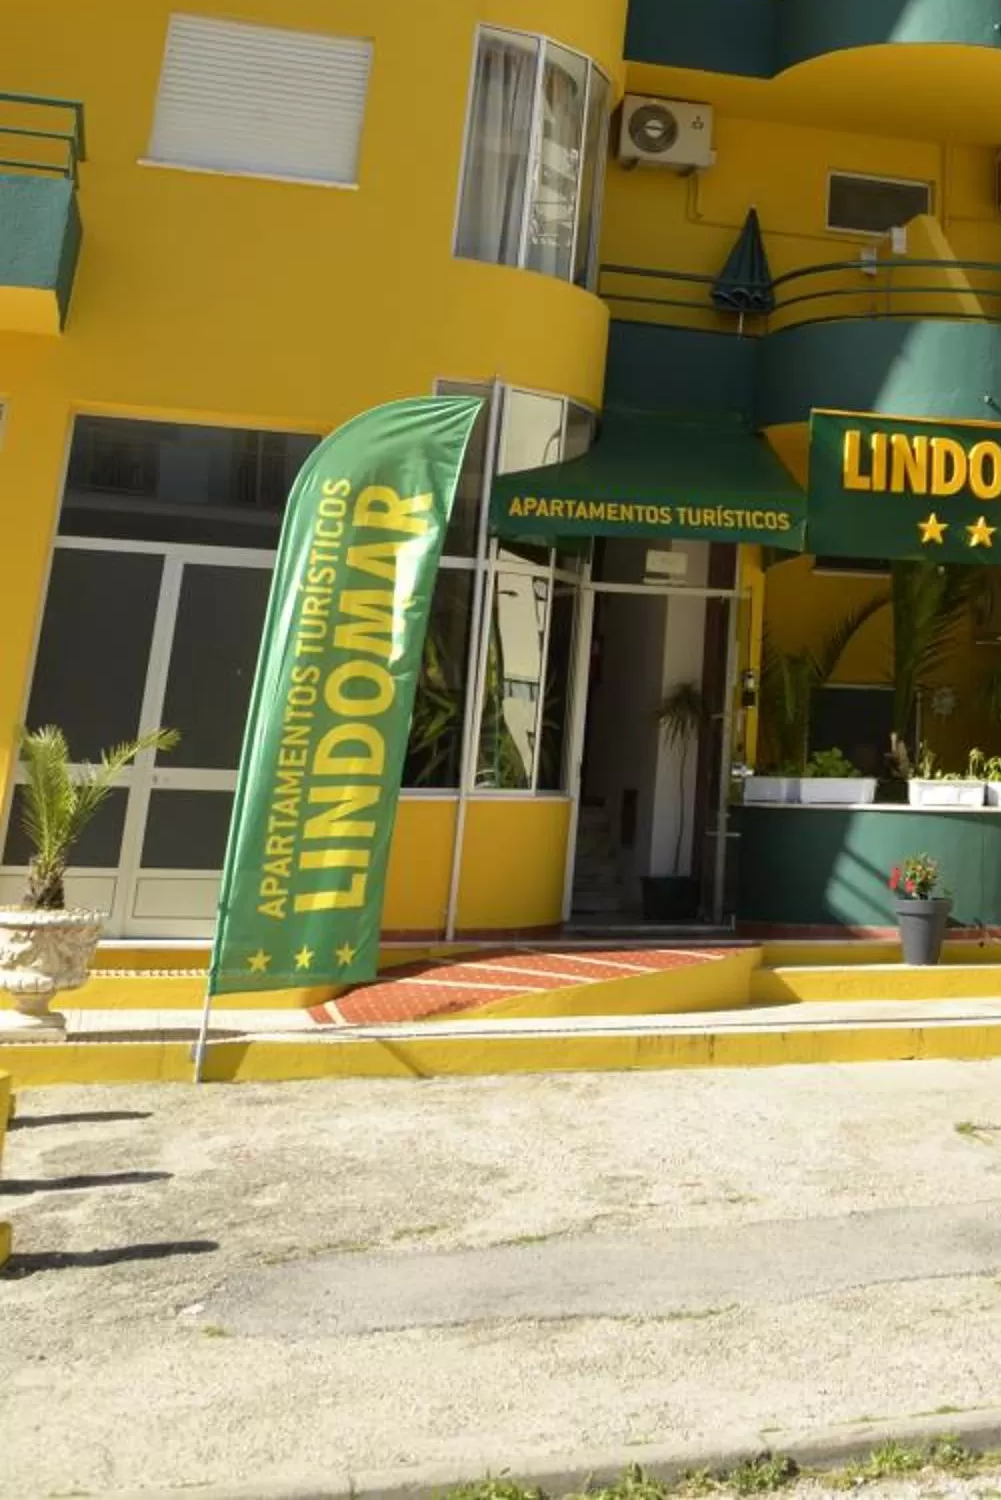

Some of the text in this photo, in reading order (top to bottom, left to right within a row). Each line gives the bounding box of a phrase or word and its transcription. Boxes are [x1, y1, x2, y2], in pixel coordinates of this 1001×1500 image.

[257, 477, 352, 920] APARTAMENTOS TURÍSTICOS
[293, 484, 434, 913] LINDOMAR
[509, 496, 791, 531] APARTAMENTOS TURÍSTICOS
